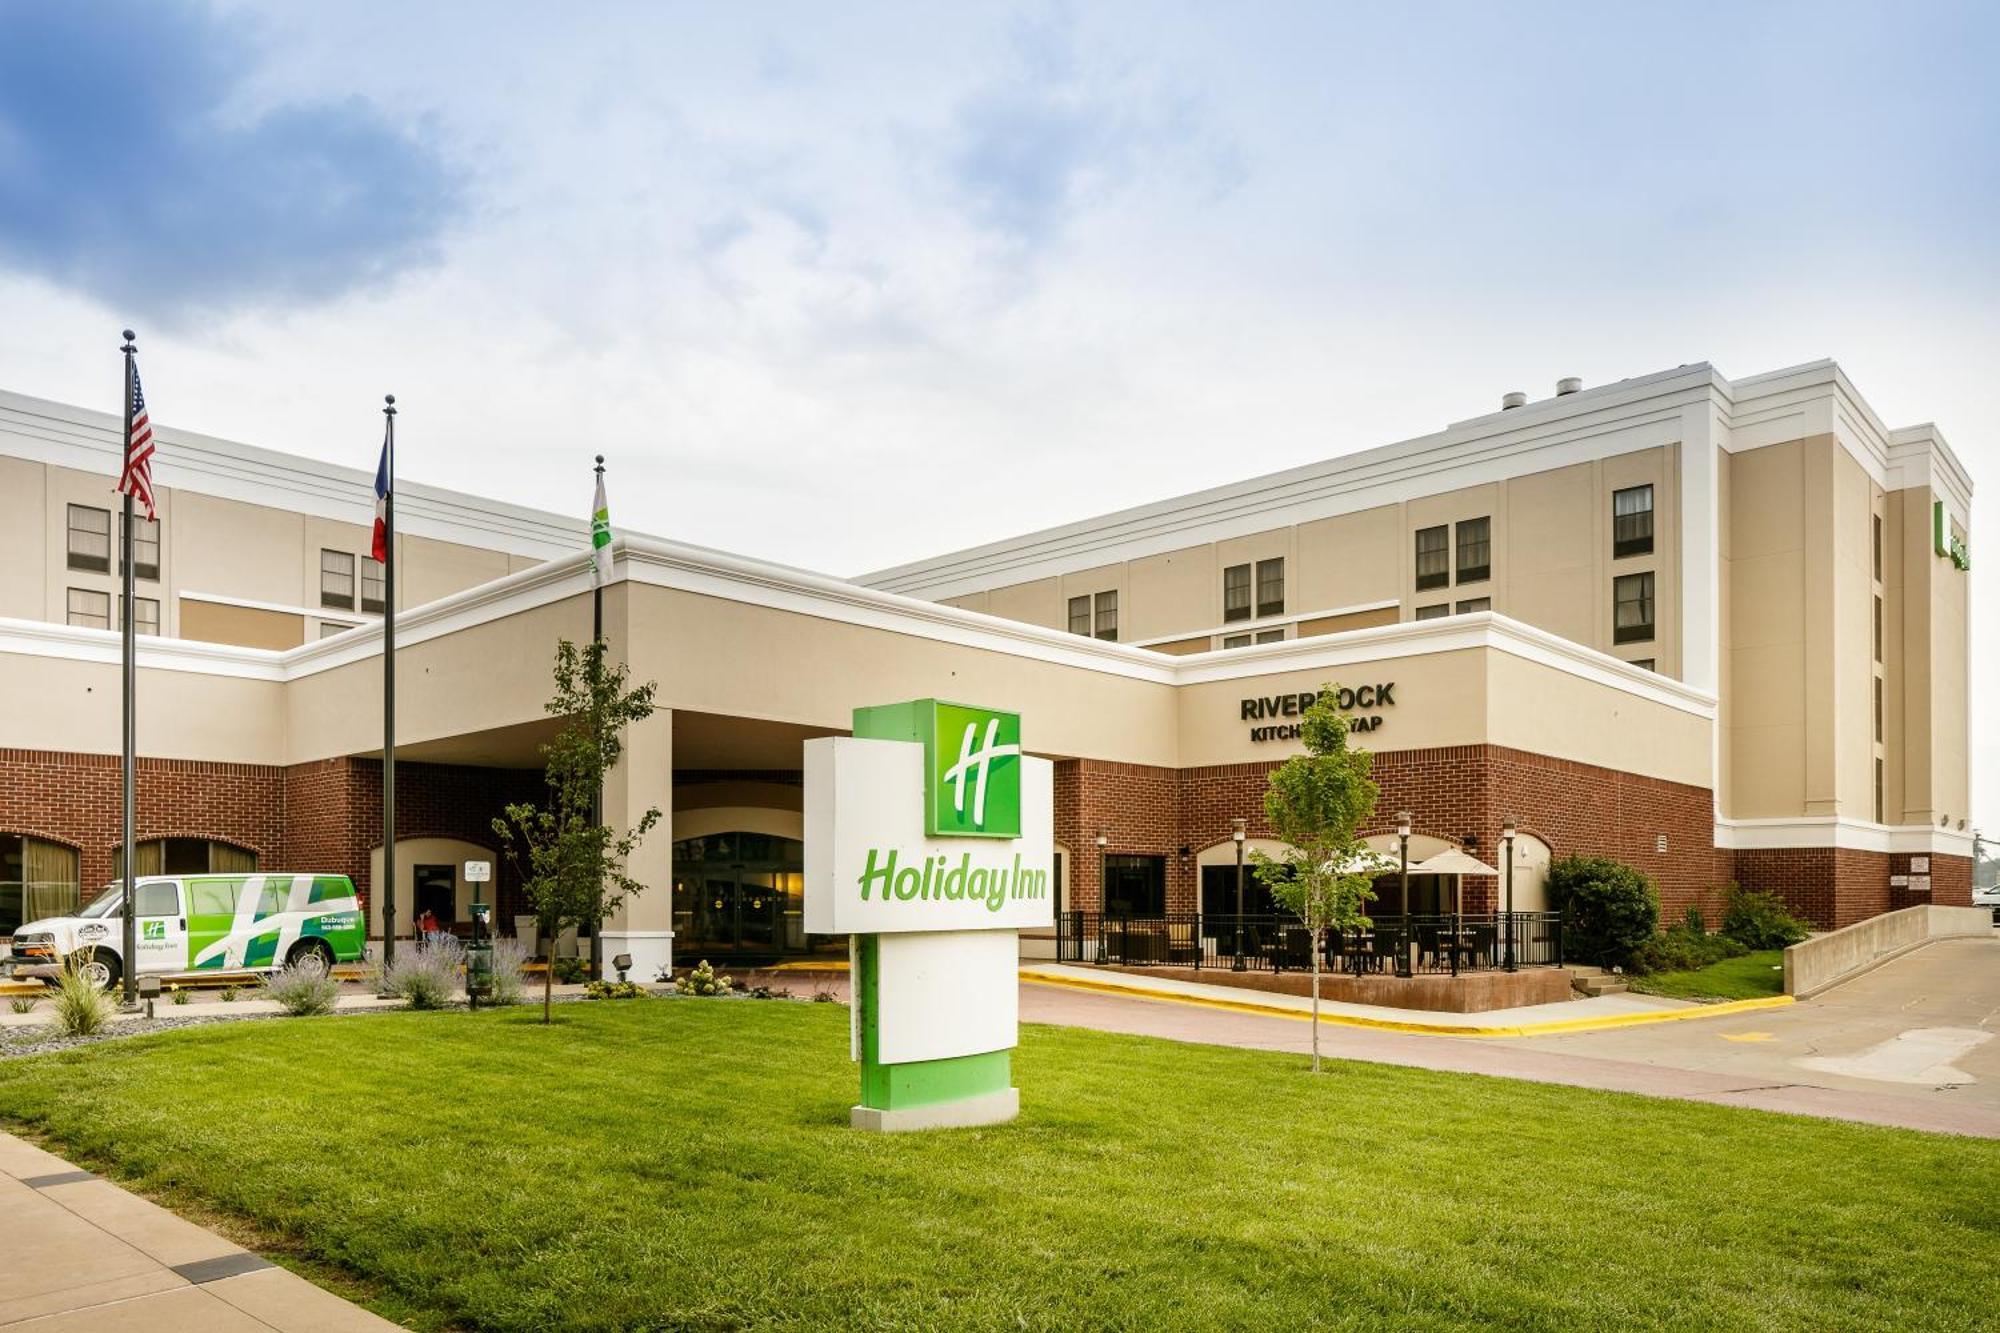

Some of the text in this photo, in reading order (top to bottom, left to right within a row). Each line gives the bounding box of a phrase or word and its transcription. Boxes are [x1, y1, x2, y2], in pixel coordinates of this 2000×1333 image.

[1251, 723, 1319, 742] KITCH
[858, 849, 1046, 912] Holiday Inn
